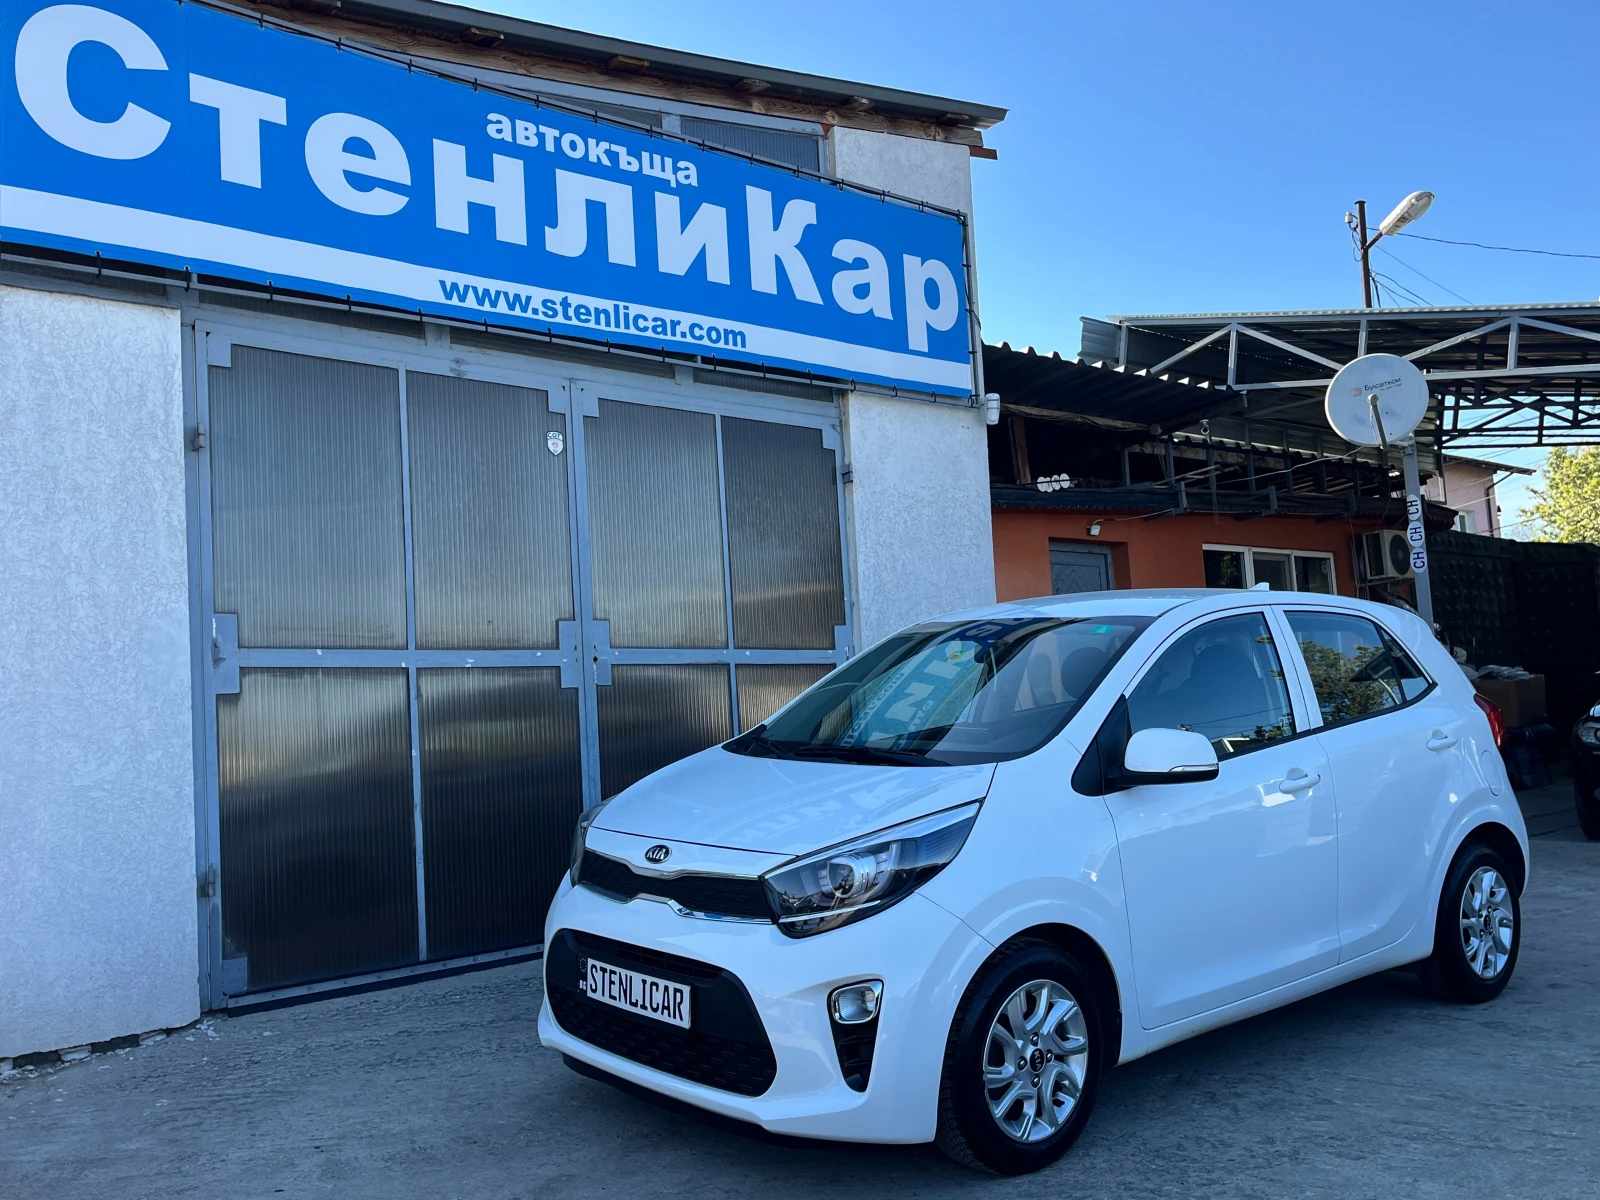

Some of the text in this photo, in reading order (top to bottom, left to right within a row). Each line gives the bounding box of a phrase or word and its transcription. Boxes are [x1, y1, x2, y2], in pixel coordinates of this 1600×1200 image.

[15, 4, 959, 353] СтенлиКар
[486, 112, 698, 188] автокъща
[438, 279, 747, 348] www.stenlicar.com
[1409, 526, 1423, 542] CH
[1412, 551, 1426, 569] CH
[647, 847, 667, 860] KIA
[590, 963, 684, 1022] STENLICAR
